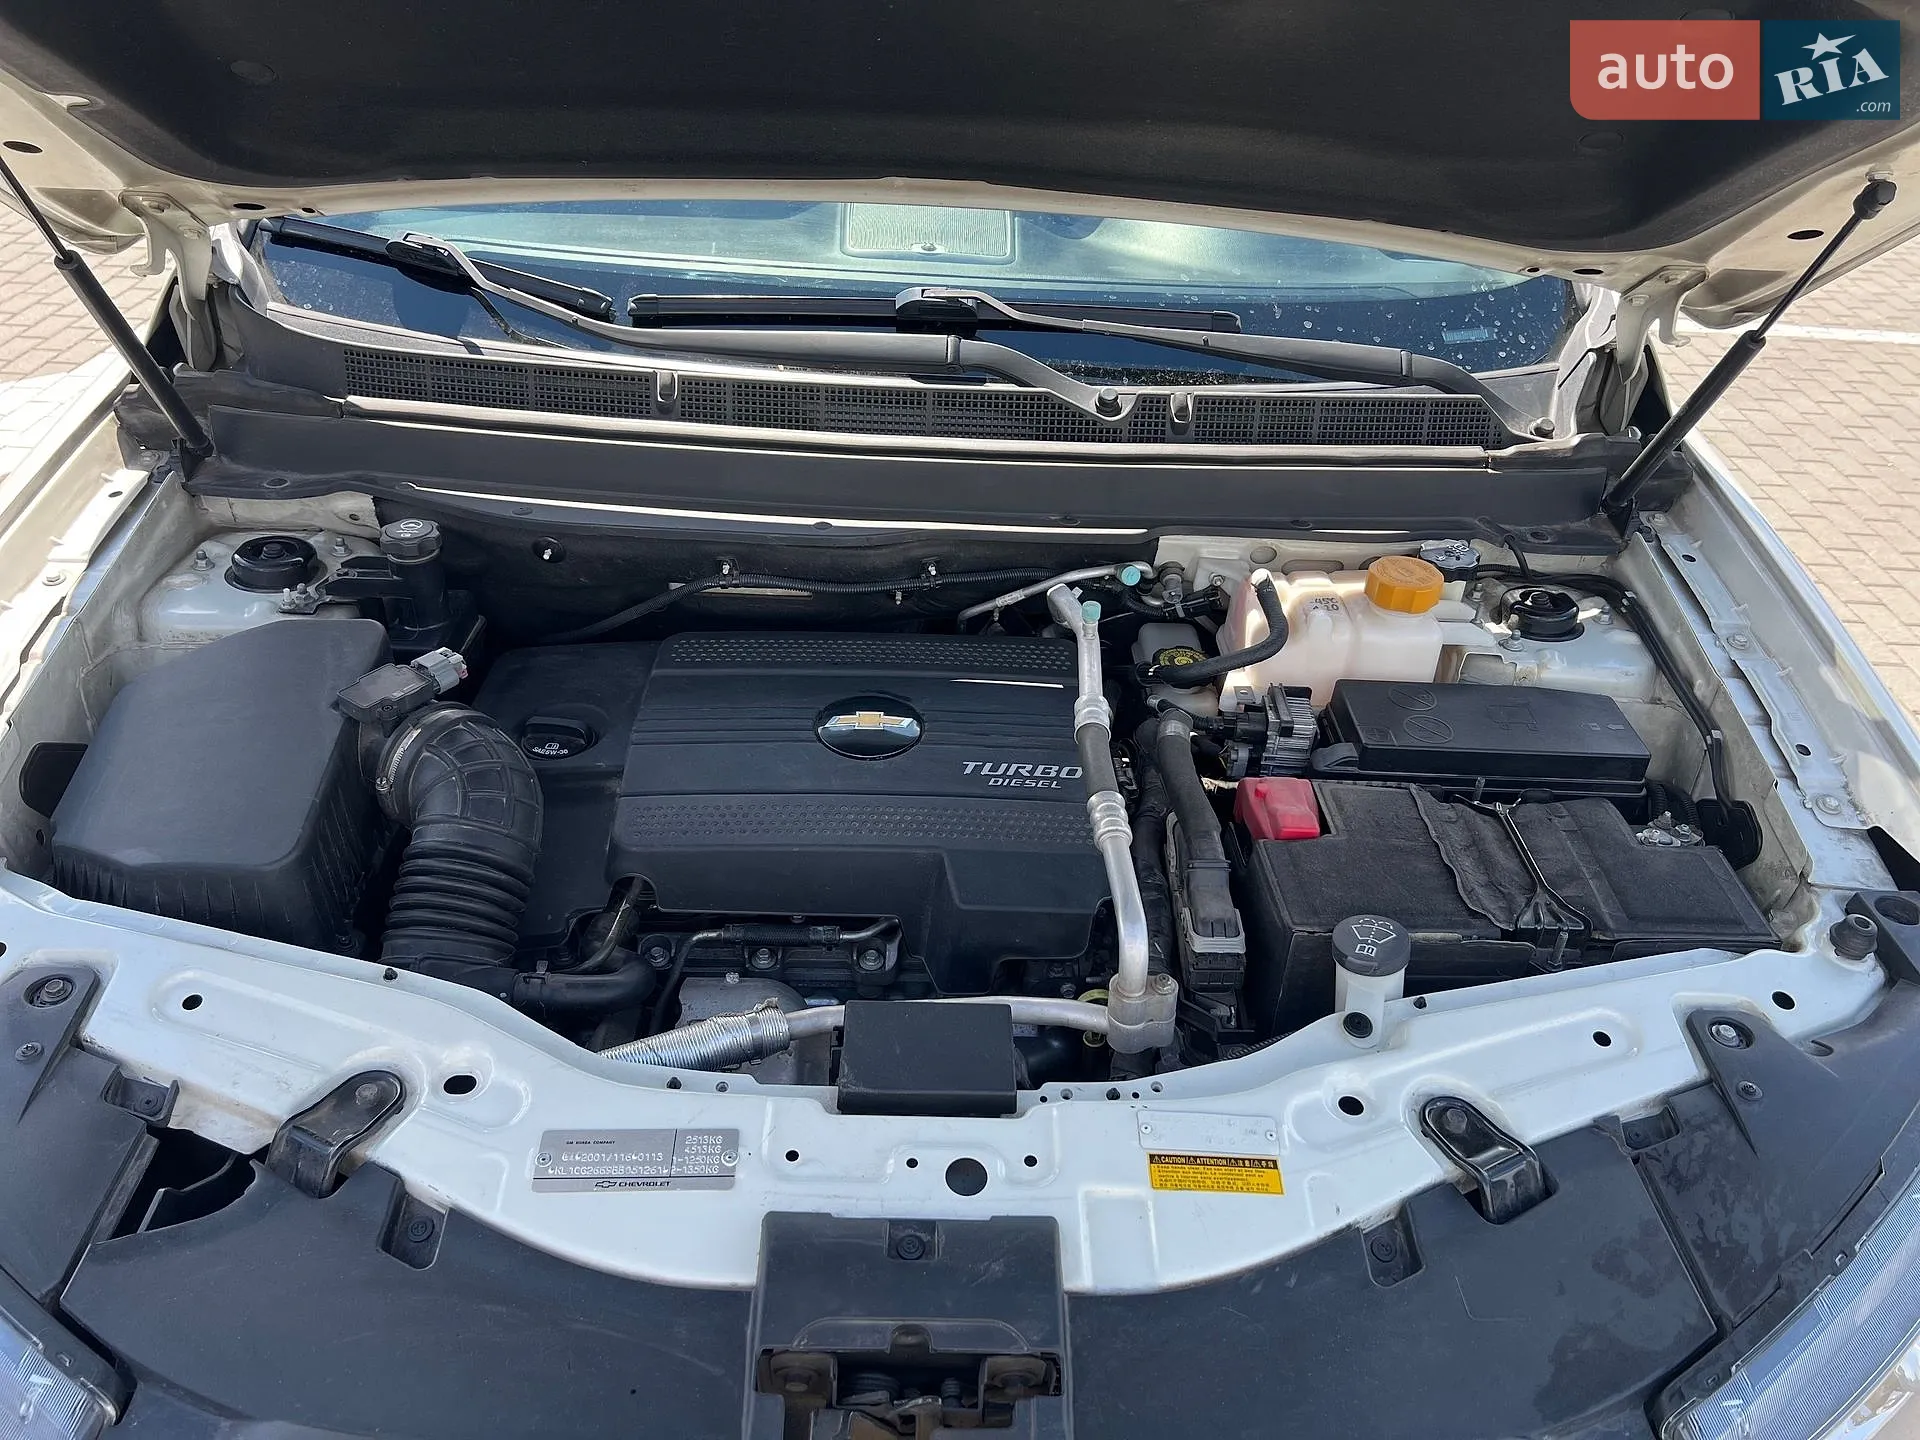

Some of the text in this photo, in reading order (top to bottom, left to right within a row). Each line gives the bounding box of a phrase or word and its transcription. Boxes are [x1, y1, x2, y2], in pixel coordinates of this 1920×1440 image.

[962, 761, 1083, 779] TURBO
[988, 777, 1062, 789] DIESEL
[685, 1135, 723, 1145] 2513KG
[1160, 1155, 1227, 1166] CAUTION ATTENTION
